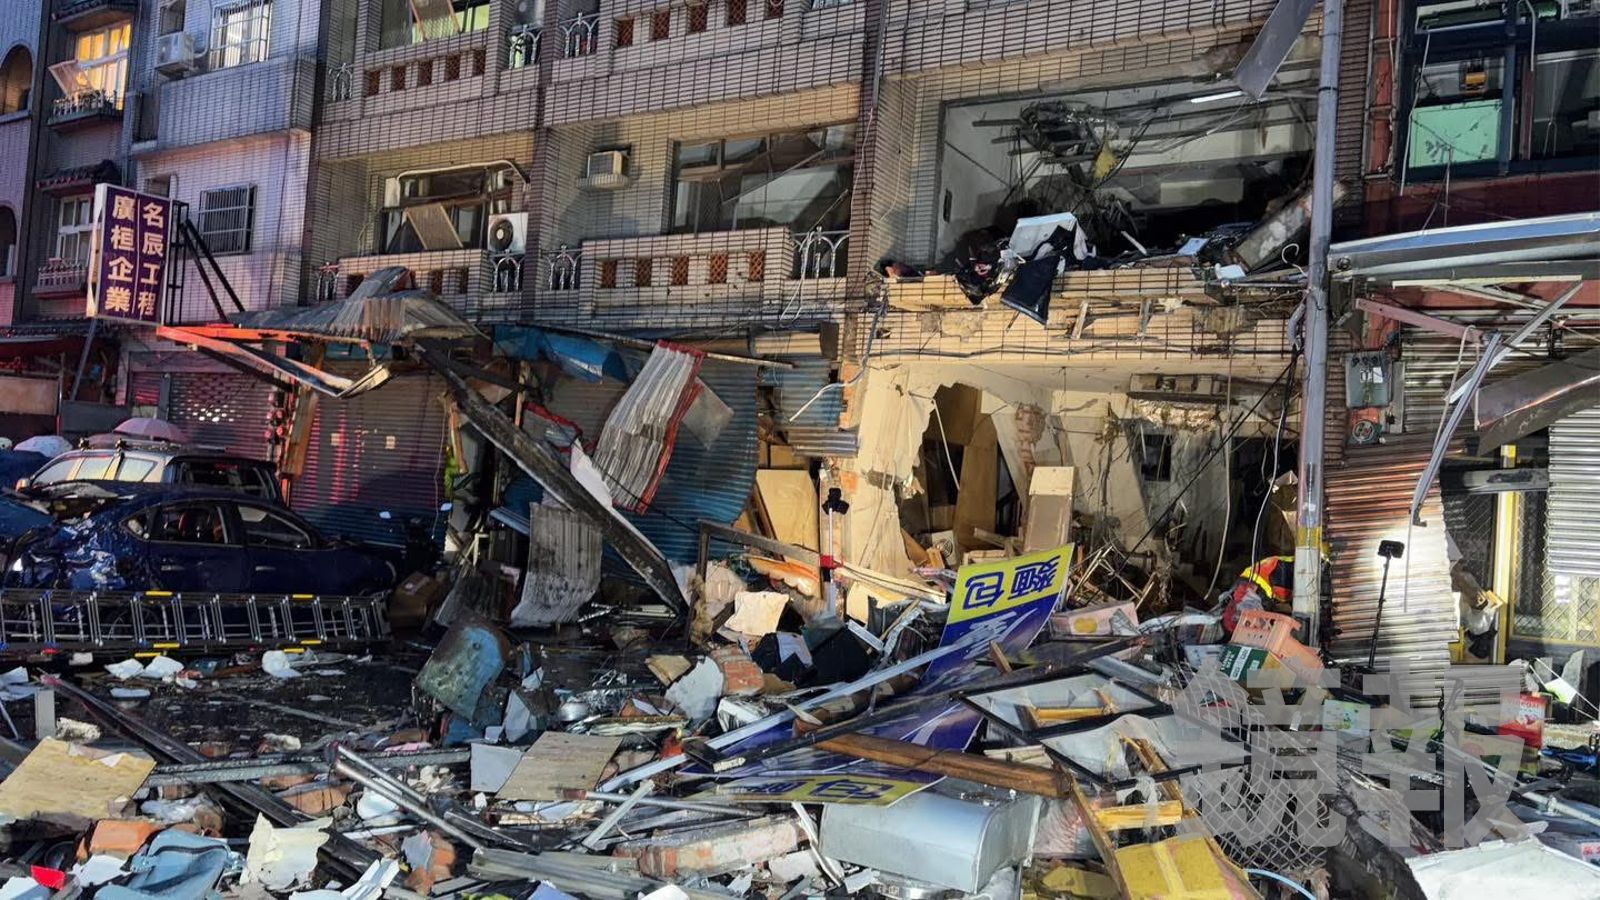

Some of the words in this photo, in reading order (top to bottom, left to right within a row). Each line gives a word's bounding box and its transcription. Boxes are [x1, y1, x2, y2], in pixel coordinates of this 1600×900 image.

[105, 195, 136, 312] 廣桓企業
[138, 203, 164, 316] 名辰工程
[962, 555, 1061, 610] 麵包
